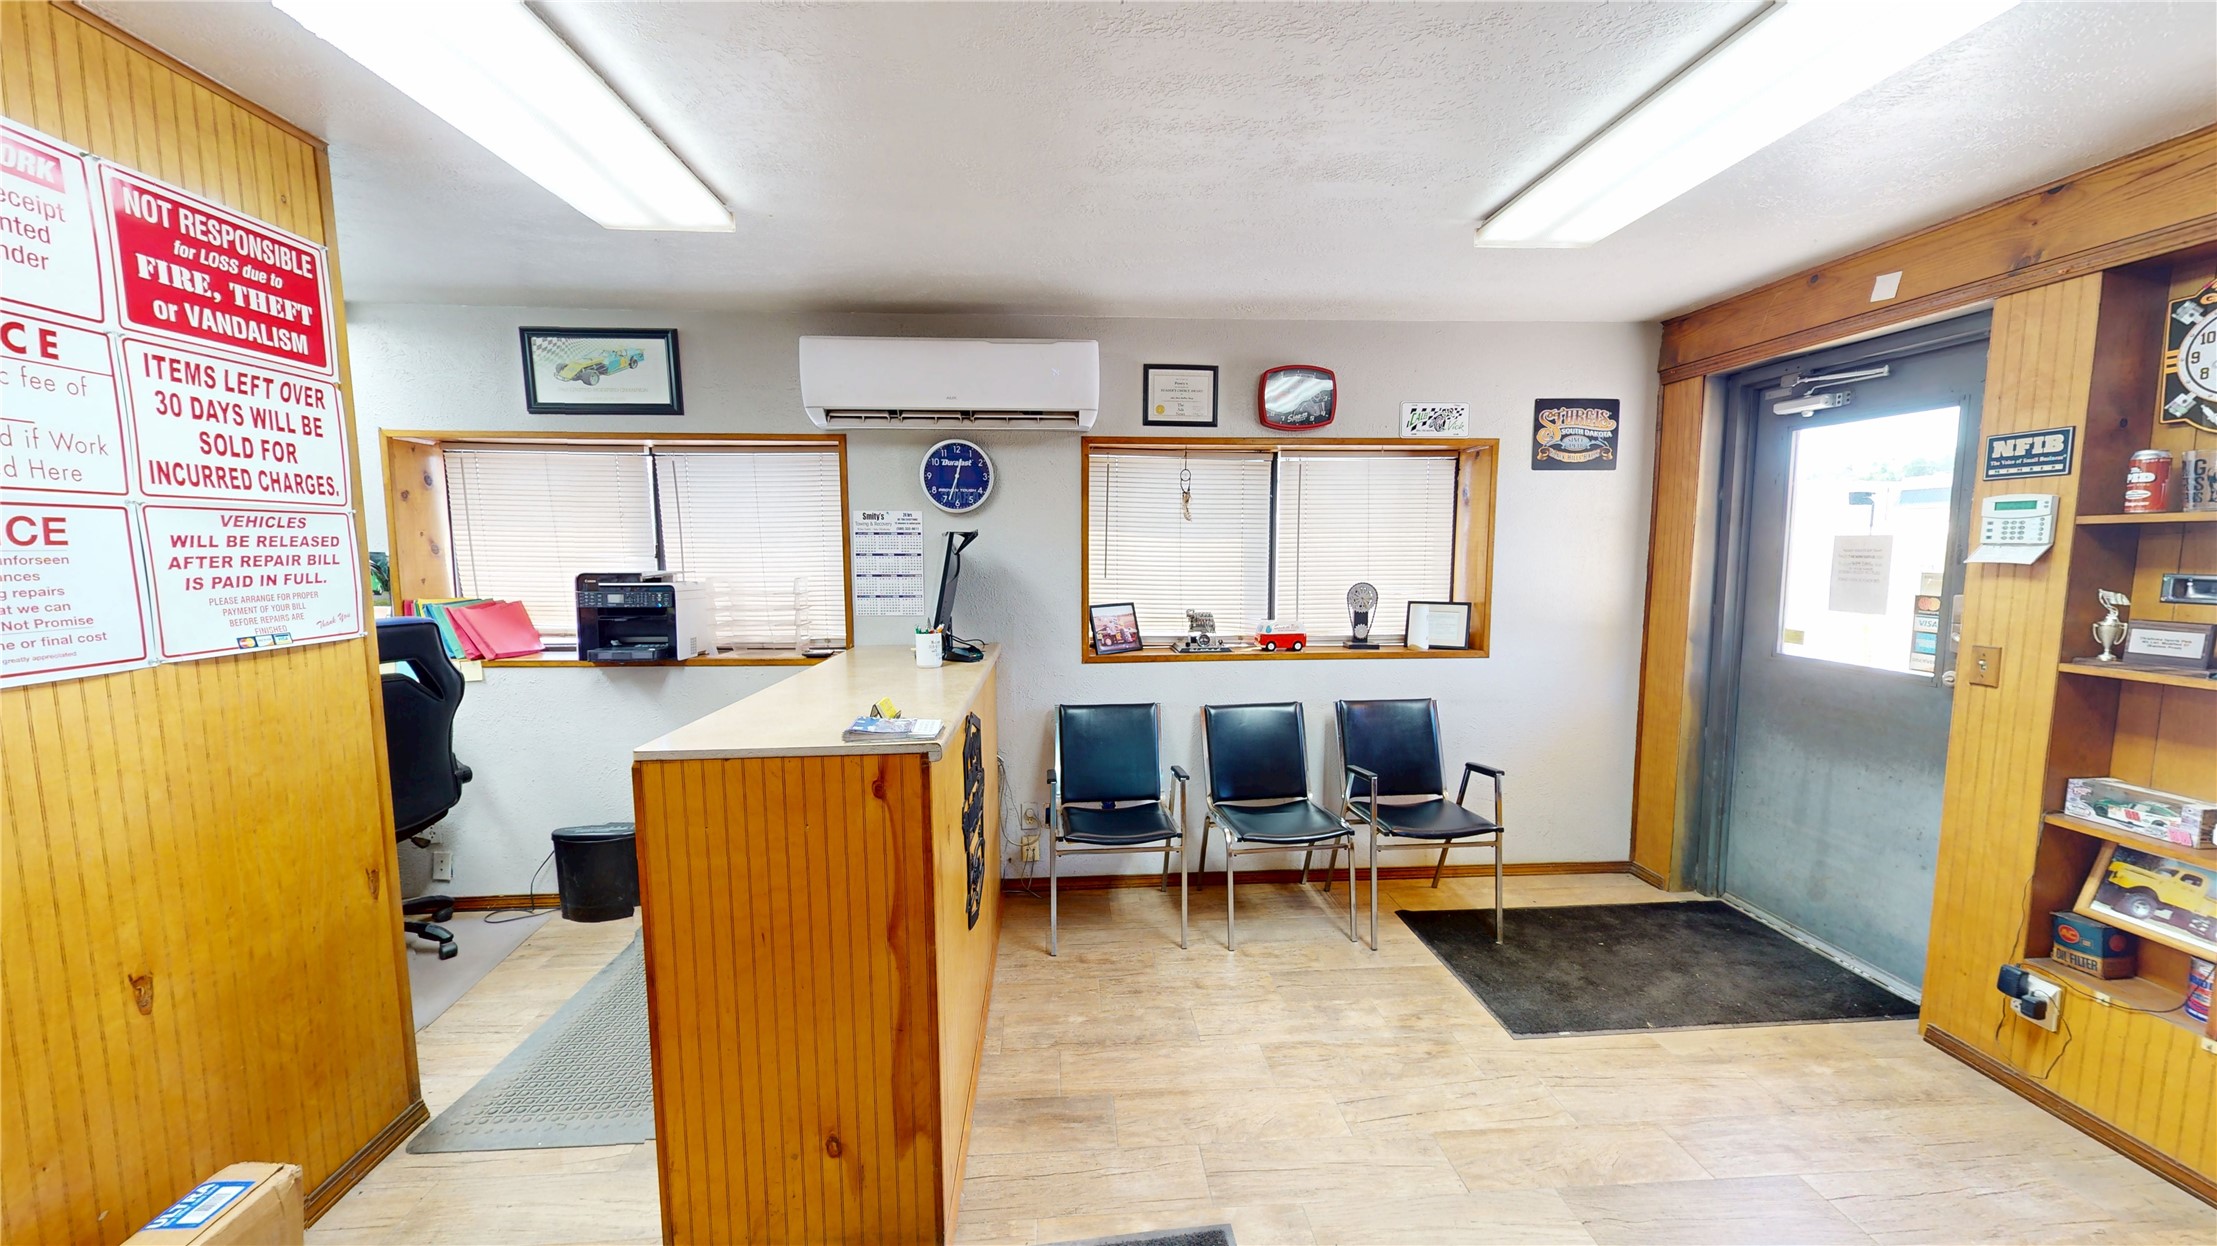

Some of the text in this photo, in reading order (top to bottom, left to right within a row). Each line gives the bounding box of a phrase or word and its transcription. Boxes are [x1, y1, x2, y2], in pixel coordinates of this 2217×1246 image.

[122, 186, 314, 279] NOT RESPONSIBLE
[173, 240, 283, 289] for LOSS due to
[135, 253, 313, 327] FIRE, THEFT
[152, 299, 310, 356] or VANDALISM
[2200, 331, 2216, 345] 10
[2191, 352, 2200, 364] 9
[21, 365, 56, 392] fee
[66, 376, 87, 397] of
[143, 352, 326, 410] ITEMS LEFT OVER
[2200, 367, 2209, 380] 8
[154, 390, 324, 438] 30 DAYS WILL BE
[1537, 407, 1617, 439] STURGIS
[1584, 429, 1613, 438] DAKOTA
[24, 427, 39, 449] if
[48, 430, 109, 456] Work
[199, 431, 299, 465] SOLD FOR
[1991, 434, 2065, 458] NFIB
[953, 446, 961, 454] 12
[28, 458, 83, 482] Here
[931, 458, 972, 467] 10 Duraast
[148, 459, 340, 497] INCURRED CHARGES.
[926, 472, 932, 480] 9
[982, 473, 988, 481] 3
[931, 486, 937, 494] 8
[220, 514, 307, 529] VEHICLES
[170, 534, 340, 549] WILL BE RELEASED
[0, 555, 70, 566] nforseen
[168, 554, 340, 570] AFTER REPAIR BILL
[0, 573, 41, 582] nces
[185, 572, 327, 591] IS PAID IN FULL.
[12, 586, 65, 600] repairs
[208, 591, 319, 606] PLEASE ARRANGE FOR PROPER
[17, 605, 40, 614] we
[44, 602, 72, 613] can
[222, 602, 307, 616] PAYMENT OF YOUR BILL
[1, 616, 95, 632] Not Promise
[229, 612, 305, 627] BEFORE REPAIRS ARE
[1919, 620, 1938, 628] VISA
[254, 625, 288, 635] FINISHED
[20, 639, 37, 649] or
[41, 634, 73, 647] final
[77, 631, 108, 644] cost
[2069, 953, 2097, 971] FILTER
